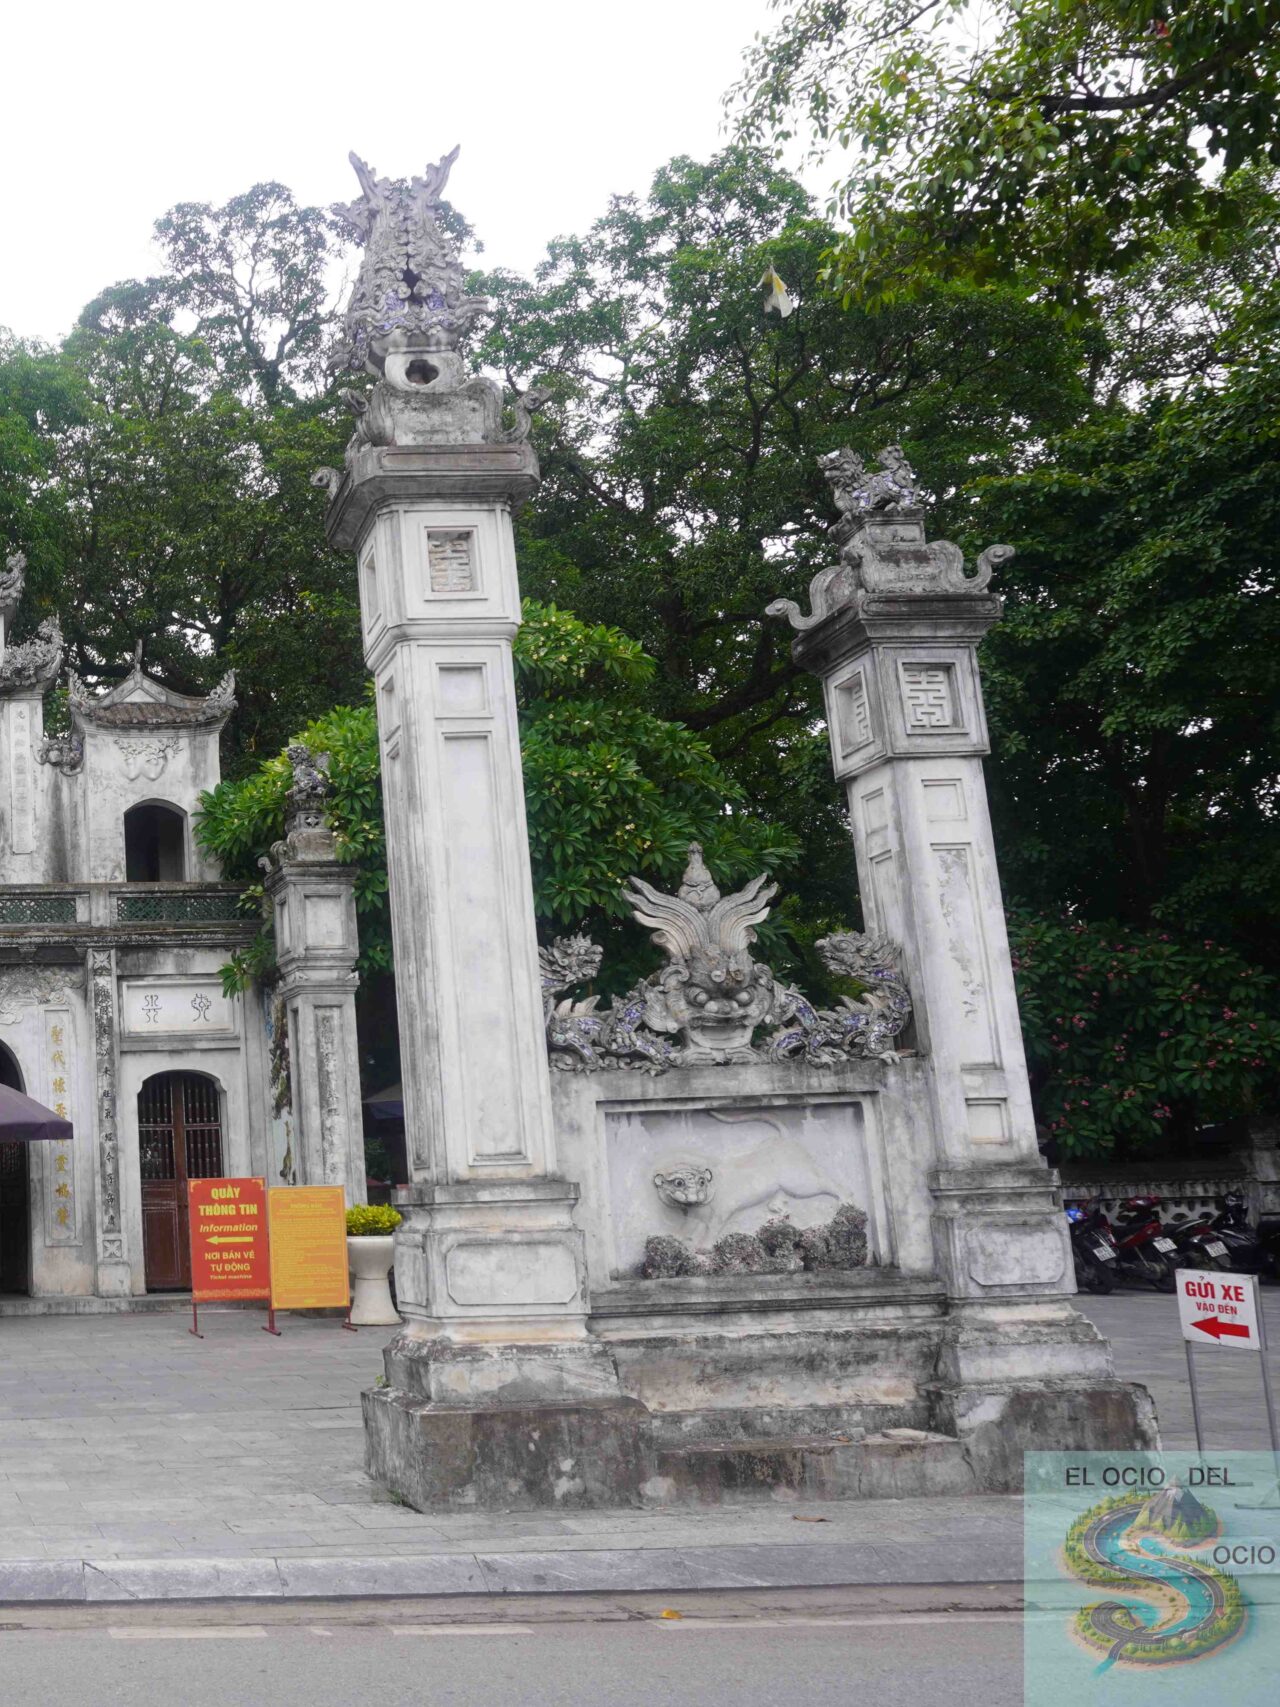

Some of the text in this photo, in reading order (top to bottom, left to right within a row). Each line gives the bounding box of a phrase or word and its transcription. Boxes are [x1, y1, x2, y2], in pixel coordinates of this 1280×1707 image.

[198, 1203, 258, 1216] THÔNG TIN
[200, 1224, 258, 1233] Information
[204, 1250, 255, 1260] NƠI BÁN VÉ
[210, 1262, 251, 1273] TỰ ĐỘNG
[1221, 1284, 1245, 1302] XE
